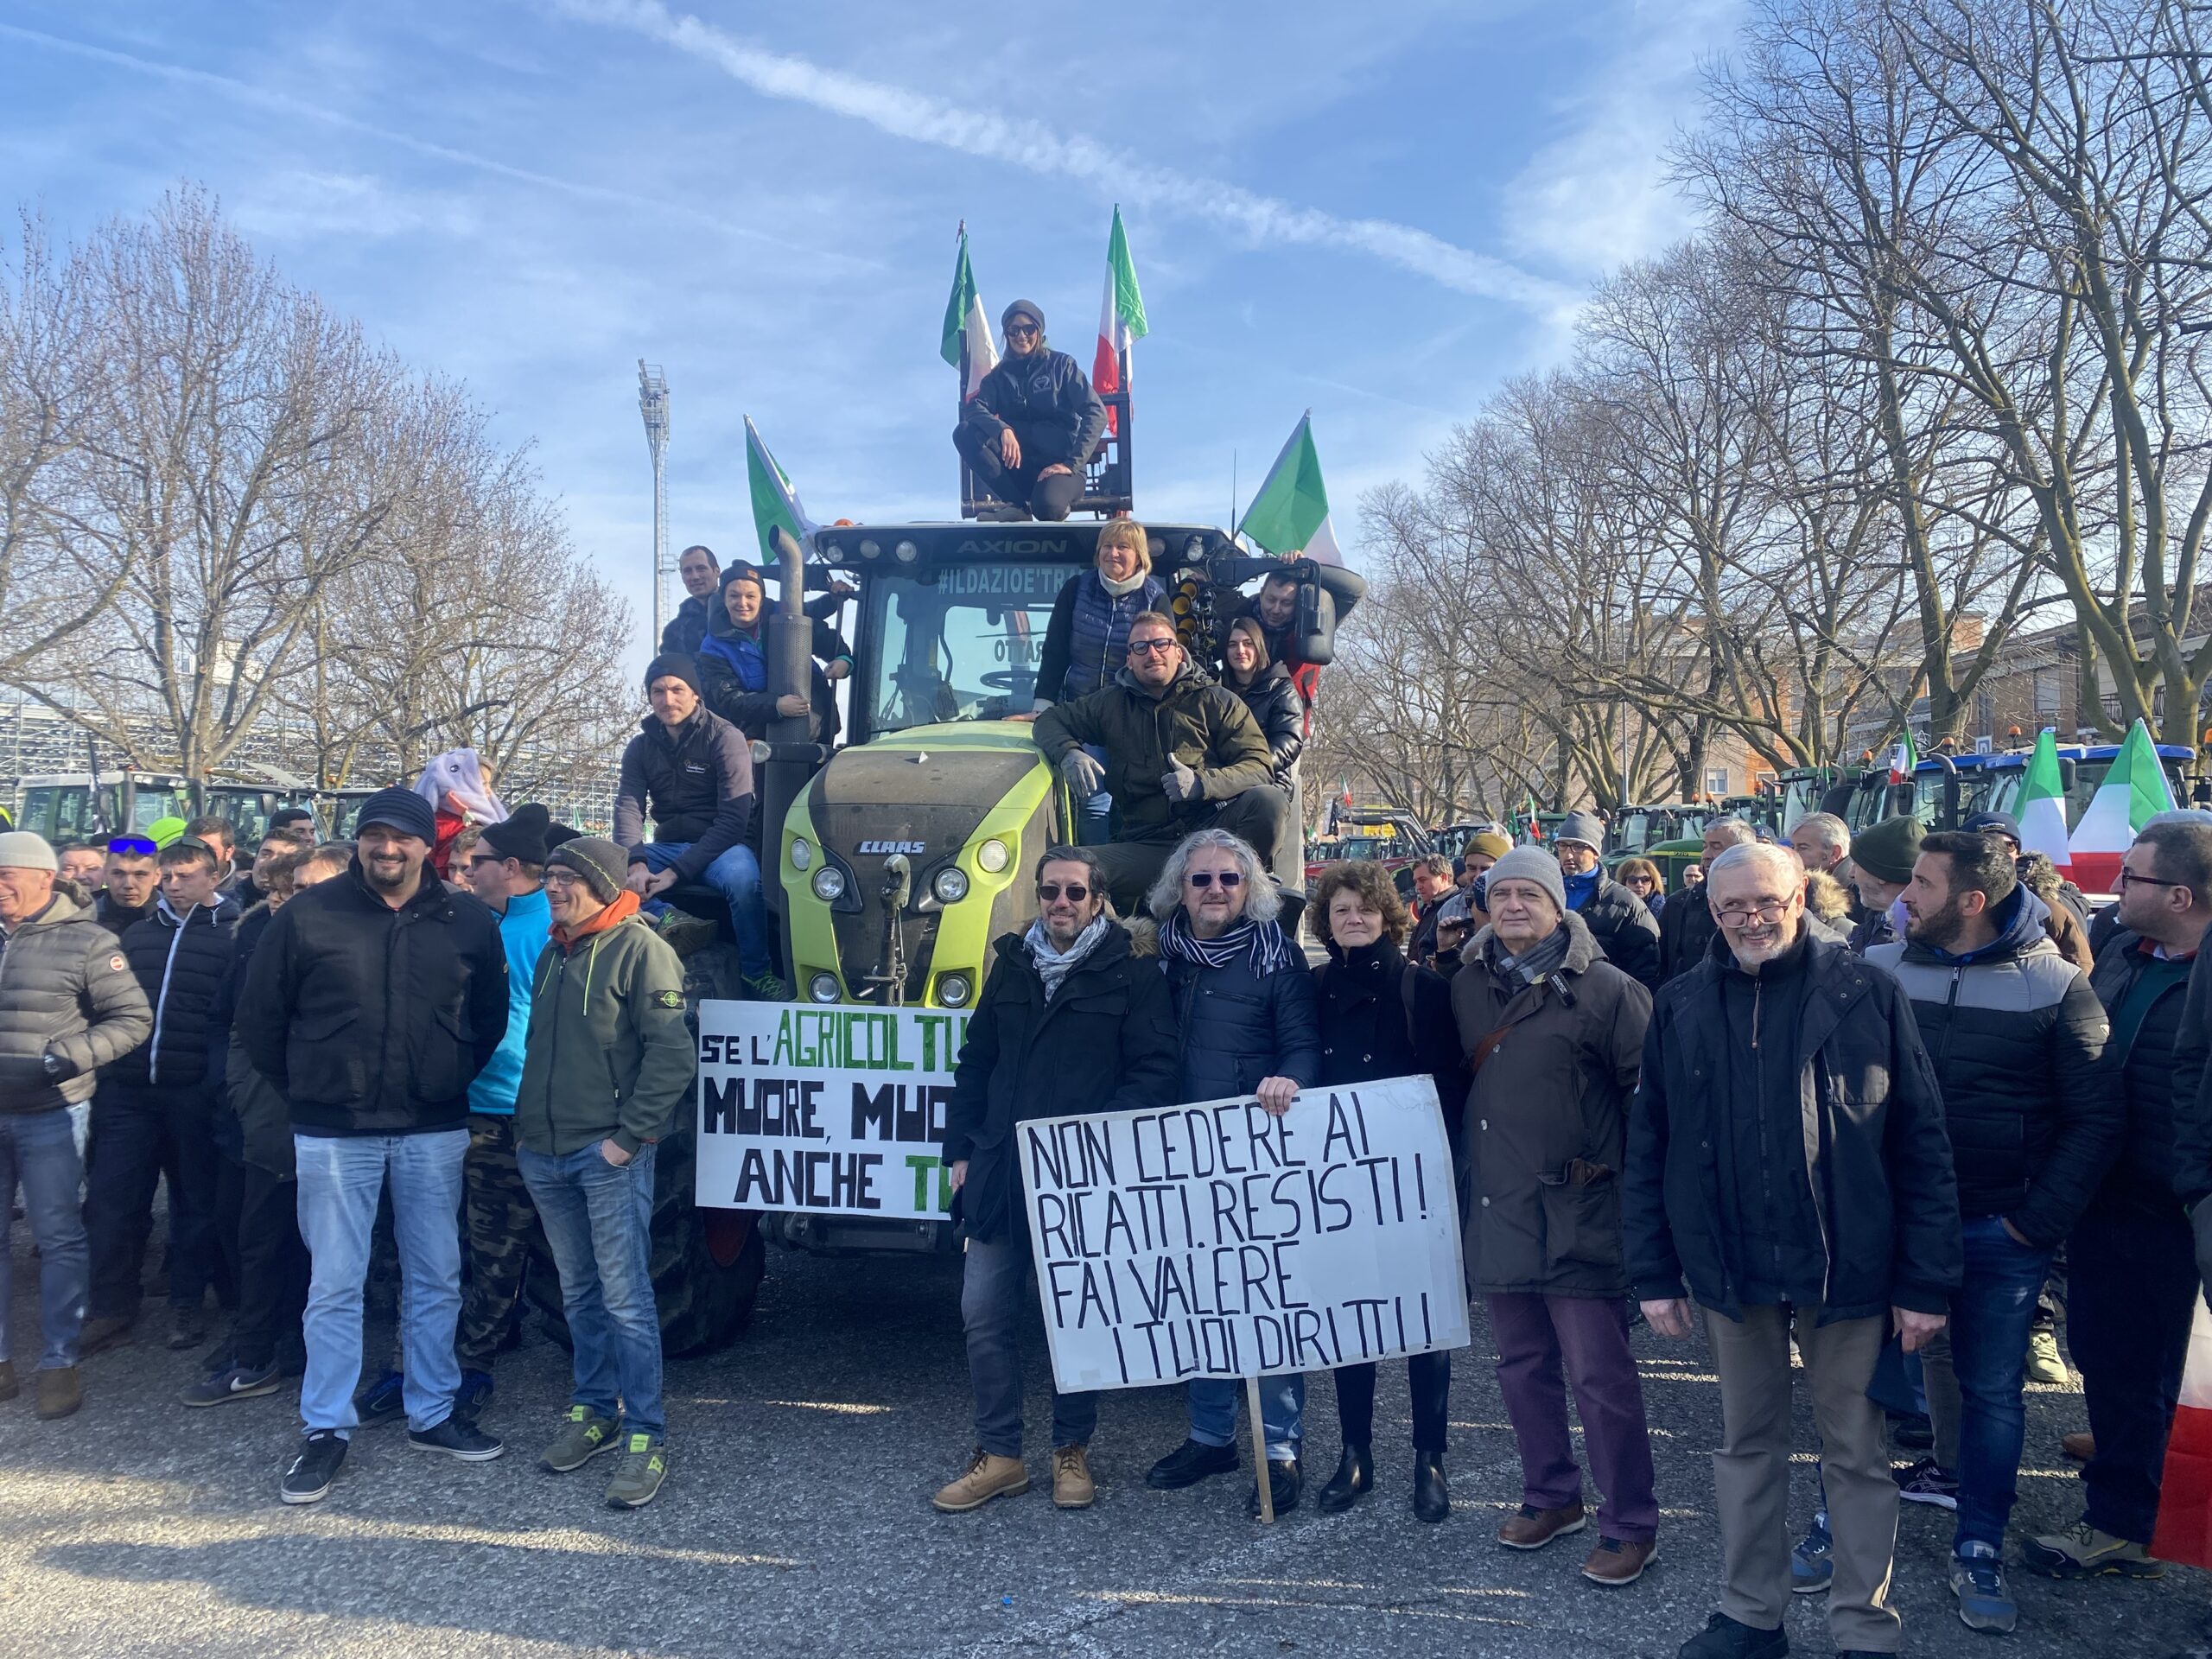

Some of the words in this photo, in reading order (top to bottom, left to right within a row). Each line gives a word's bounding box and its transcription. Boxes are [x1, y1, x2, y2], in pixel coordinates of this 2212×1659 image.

[956, 539, 1068, 554] AXION
[859, 841, 925, 854] CLAAS
[701, 1034, 742, 1065] SE
[703, 1077, 831, 1145] MUORE,
[1027, 1121, 1116, 1190] NON
[1133, 1096, 1306, 1182] CEDERE
[1323, 1091, 1369, 1162] AI
[733, 1148, 883, 1210] ANCHE
[1210, 1154, 1427, 1243] RESISTI!
[1047, 1260, 1122, 1330] FAI
[1126, 1240, 1309, 1324] VALERE
[1112, 1327, 1128, 1384] I
[1133, 1318, 1240, 1379] TUOI
[1254, 1293, 1433, 1371] DIRITTI!
